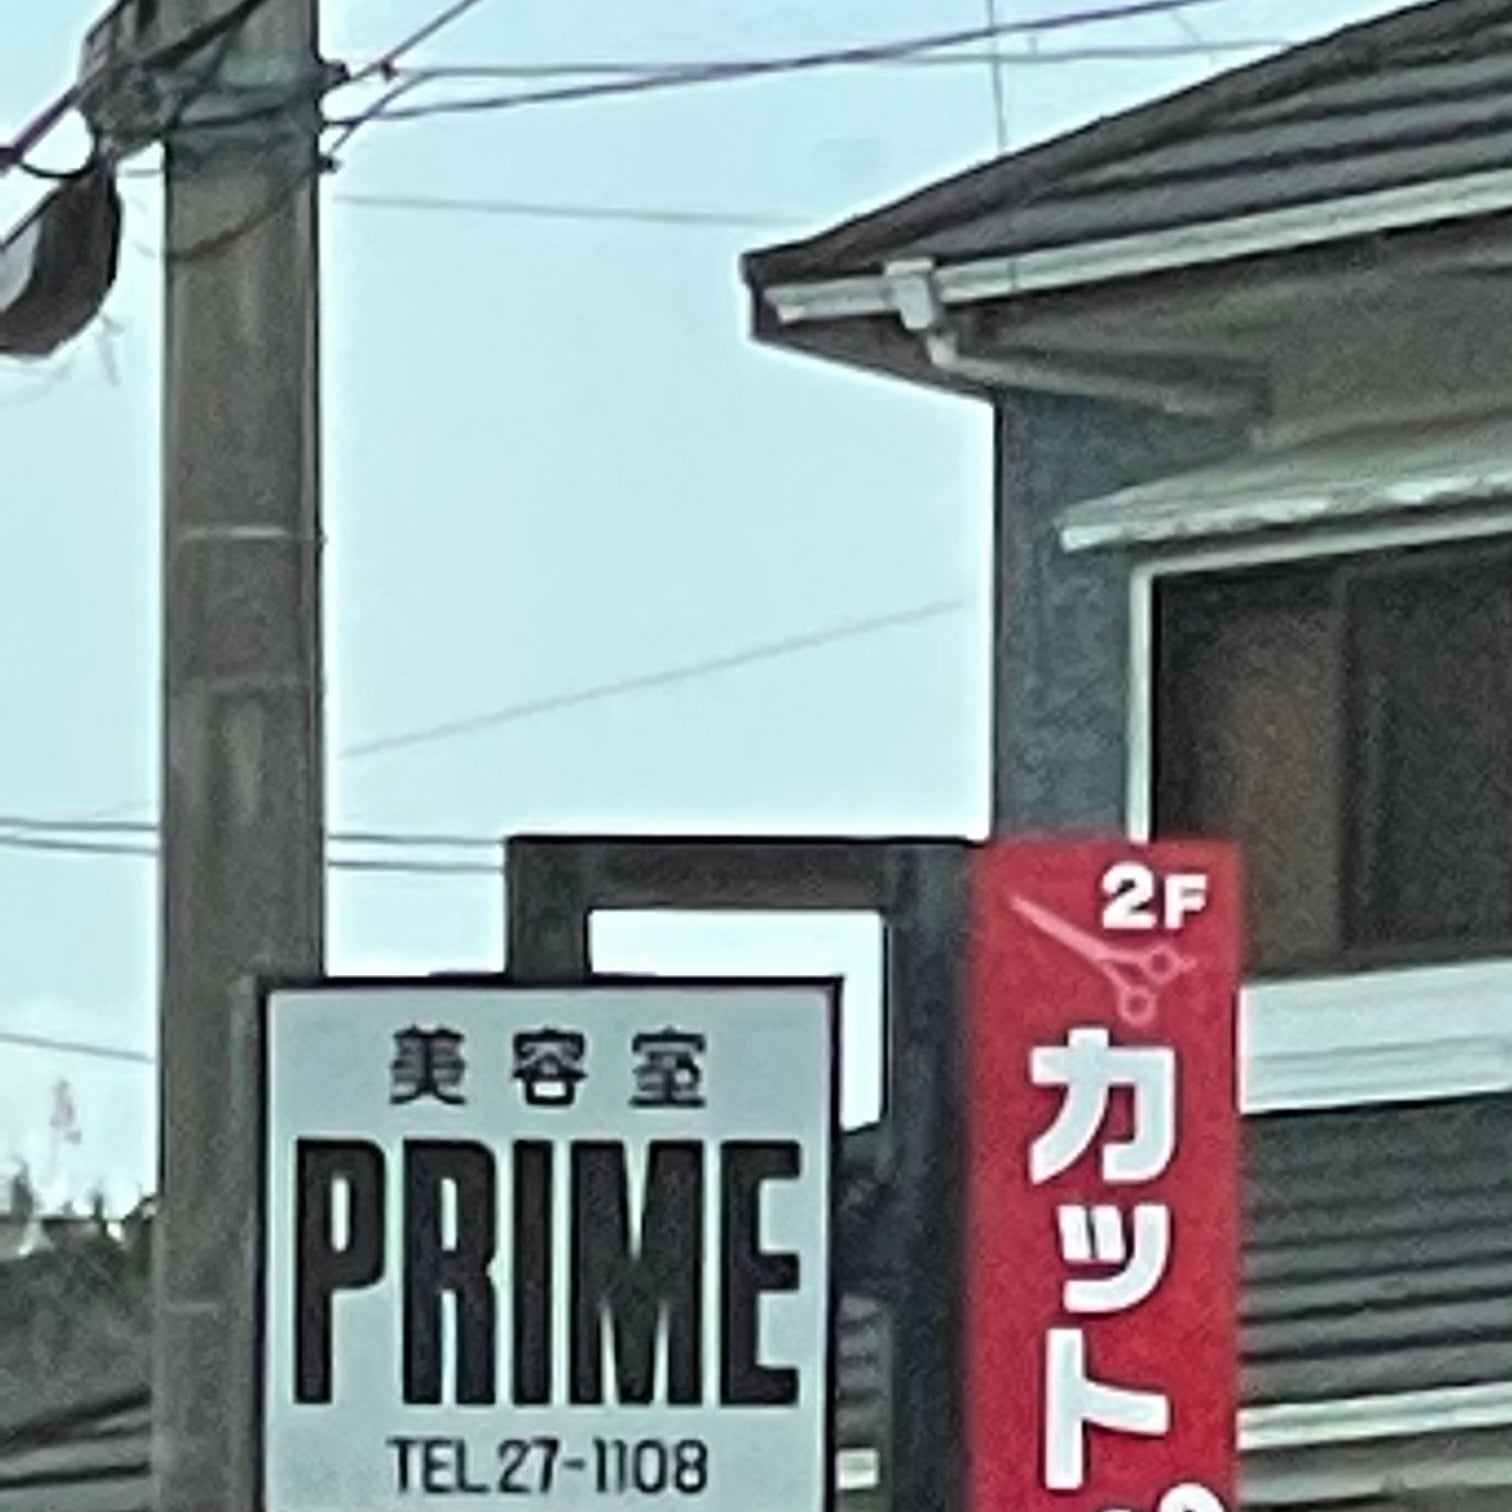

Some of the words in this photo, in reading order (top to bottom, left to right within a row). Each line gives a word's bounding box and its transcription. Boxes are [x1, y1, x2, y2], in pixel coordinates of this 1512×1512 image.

[1102, 861, 1208, 930] 2F
[389, 1025, 707, 1108] 美容室
[293, 1137, 802, 1407] PRIME
[1030, 1027, 1177, 1491] カット
